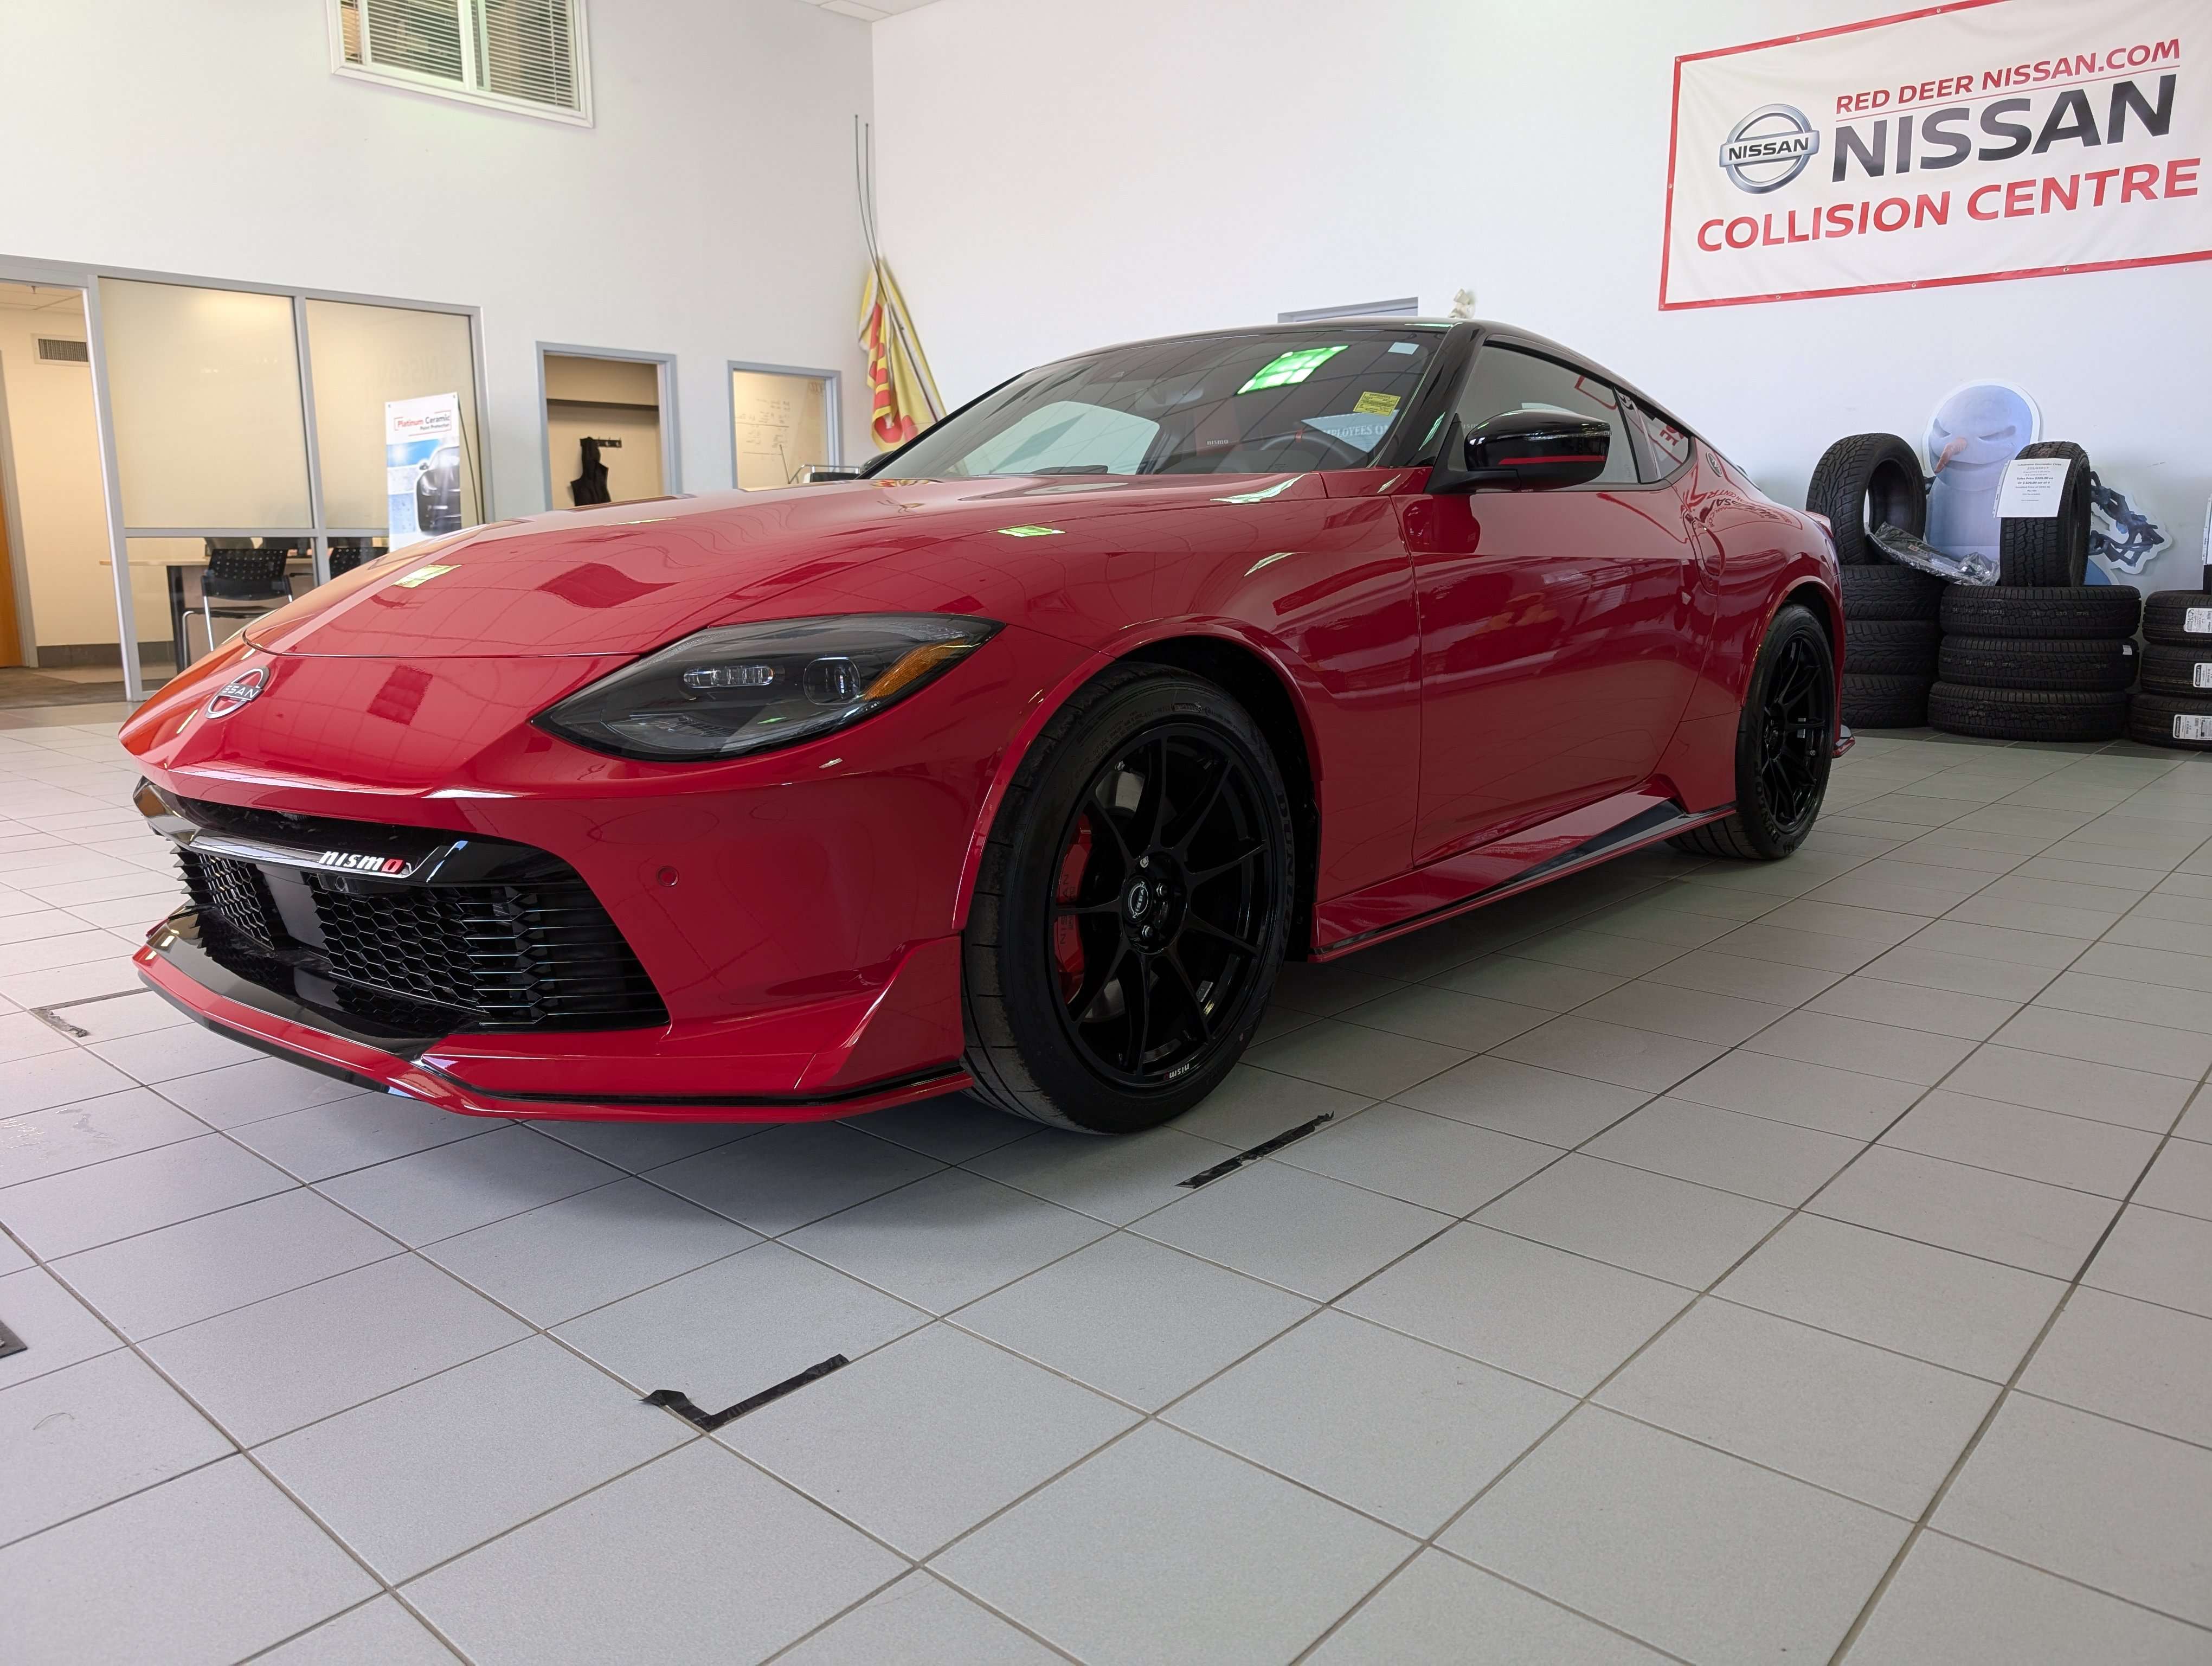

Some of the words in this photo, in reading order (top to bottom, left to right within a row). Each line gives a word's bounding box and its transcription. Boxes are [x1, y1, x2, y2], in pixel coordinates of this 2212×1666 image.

[1836, 89, 1890, 114] RED
[1898, 75, 1973, 104] DEER
[1982, 38, 2181, 90] NISSAN.COM
[1727, 137, 1810, 162] NISSAN
[1831, 74, 2177, 183] NISSAN
[1696, 191, 1951, 252] COLLISION
[1966, 158, 2201, 221] CENTRE
[425, 414, 451, 424] Ceramic
[1060, 874, 1069, 945] NISAN
[1132, 881, 1145, 919] NISSAN
